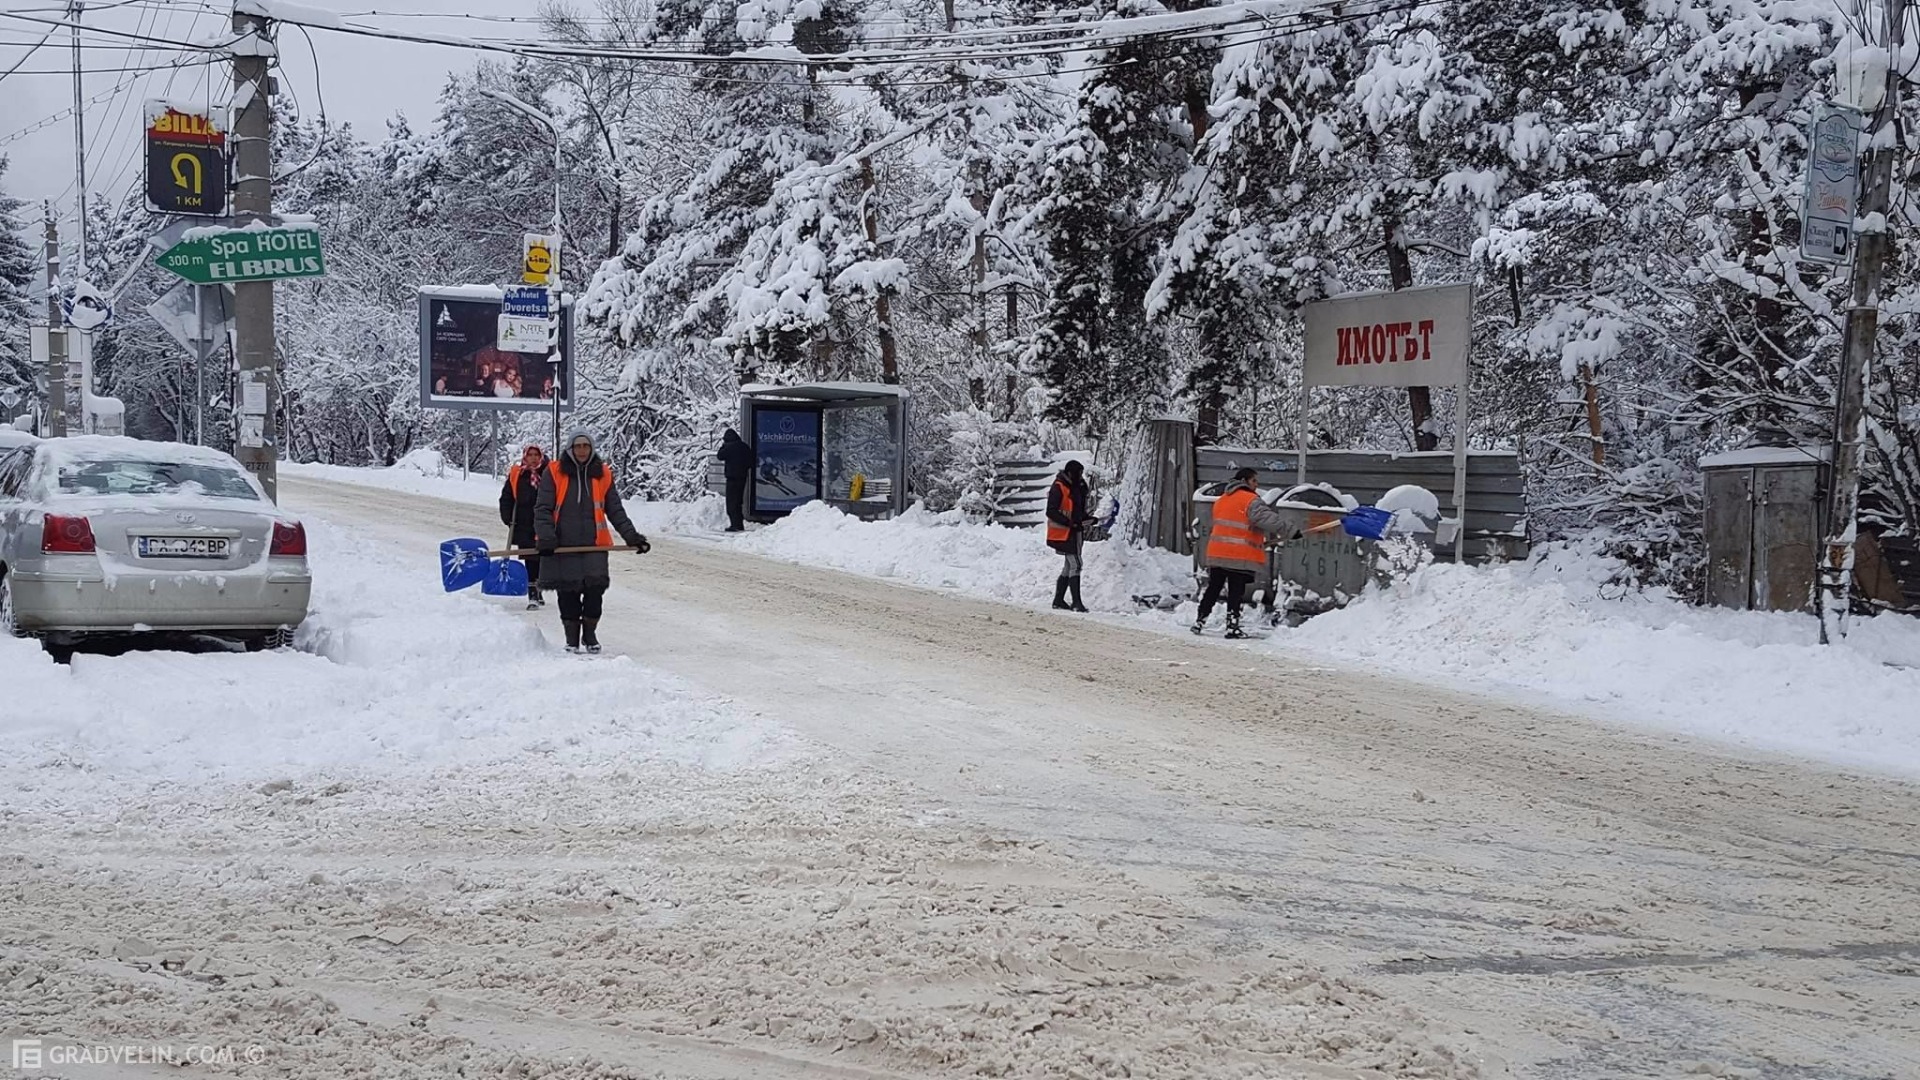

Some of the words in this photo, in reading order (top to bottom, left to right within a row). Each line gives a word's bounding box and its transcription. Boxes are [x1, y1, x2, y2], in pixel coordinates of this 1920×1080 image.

[154, 114, 218, 136] BILLA
[176, 196, 180, 205] 1
[211, 238, 249, 259] Spa
[256, 232, 317, 252] HOTEL
[168, 255, 189, 267] 300
[192, 255, 204, 265] m
[209, 256, 320, 279] ELBRUS
[521, 291, 539, 299] Hotel
[504, 302, 547, 313] Dvoretsa
[1336, 319, 1434, 366] ИМОТЪТ
